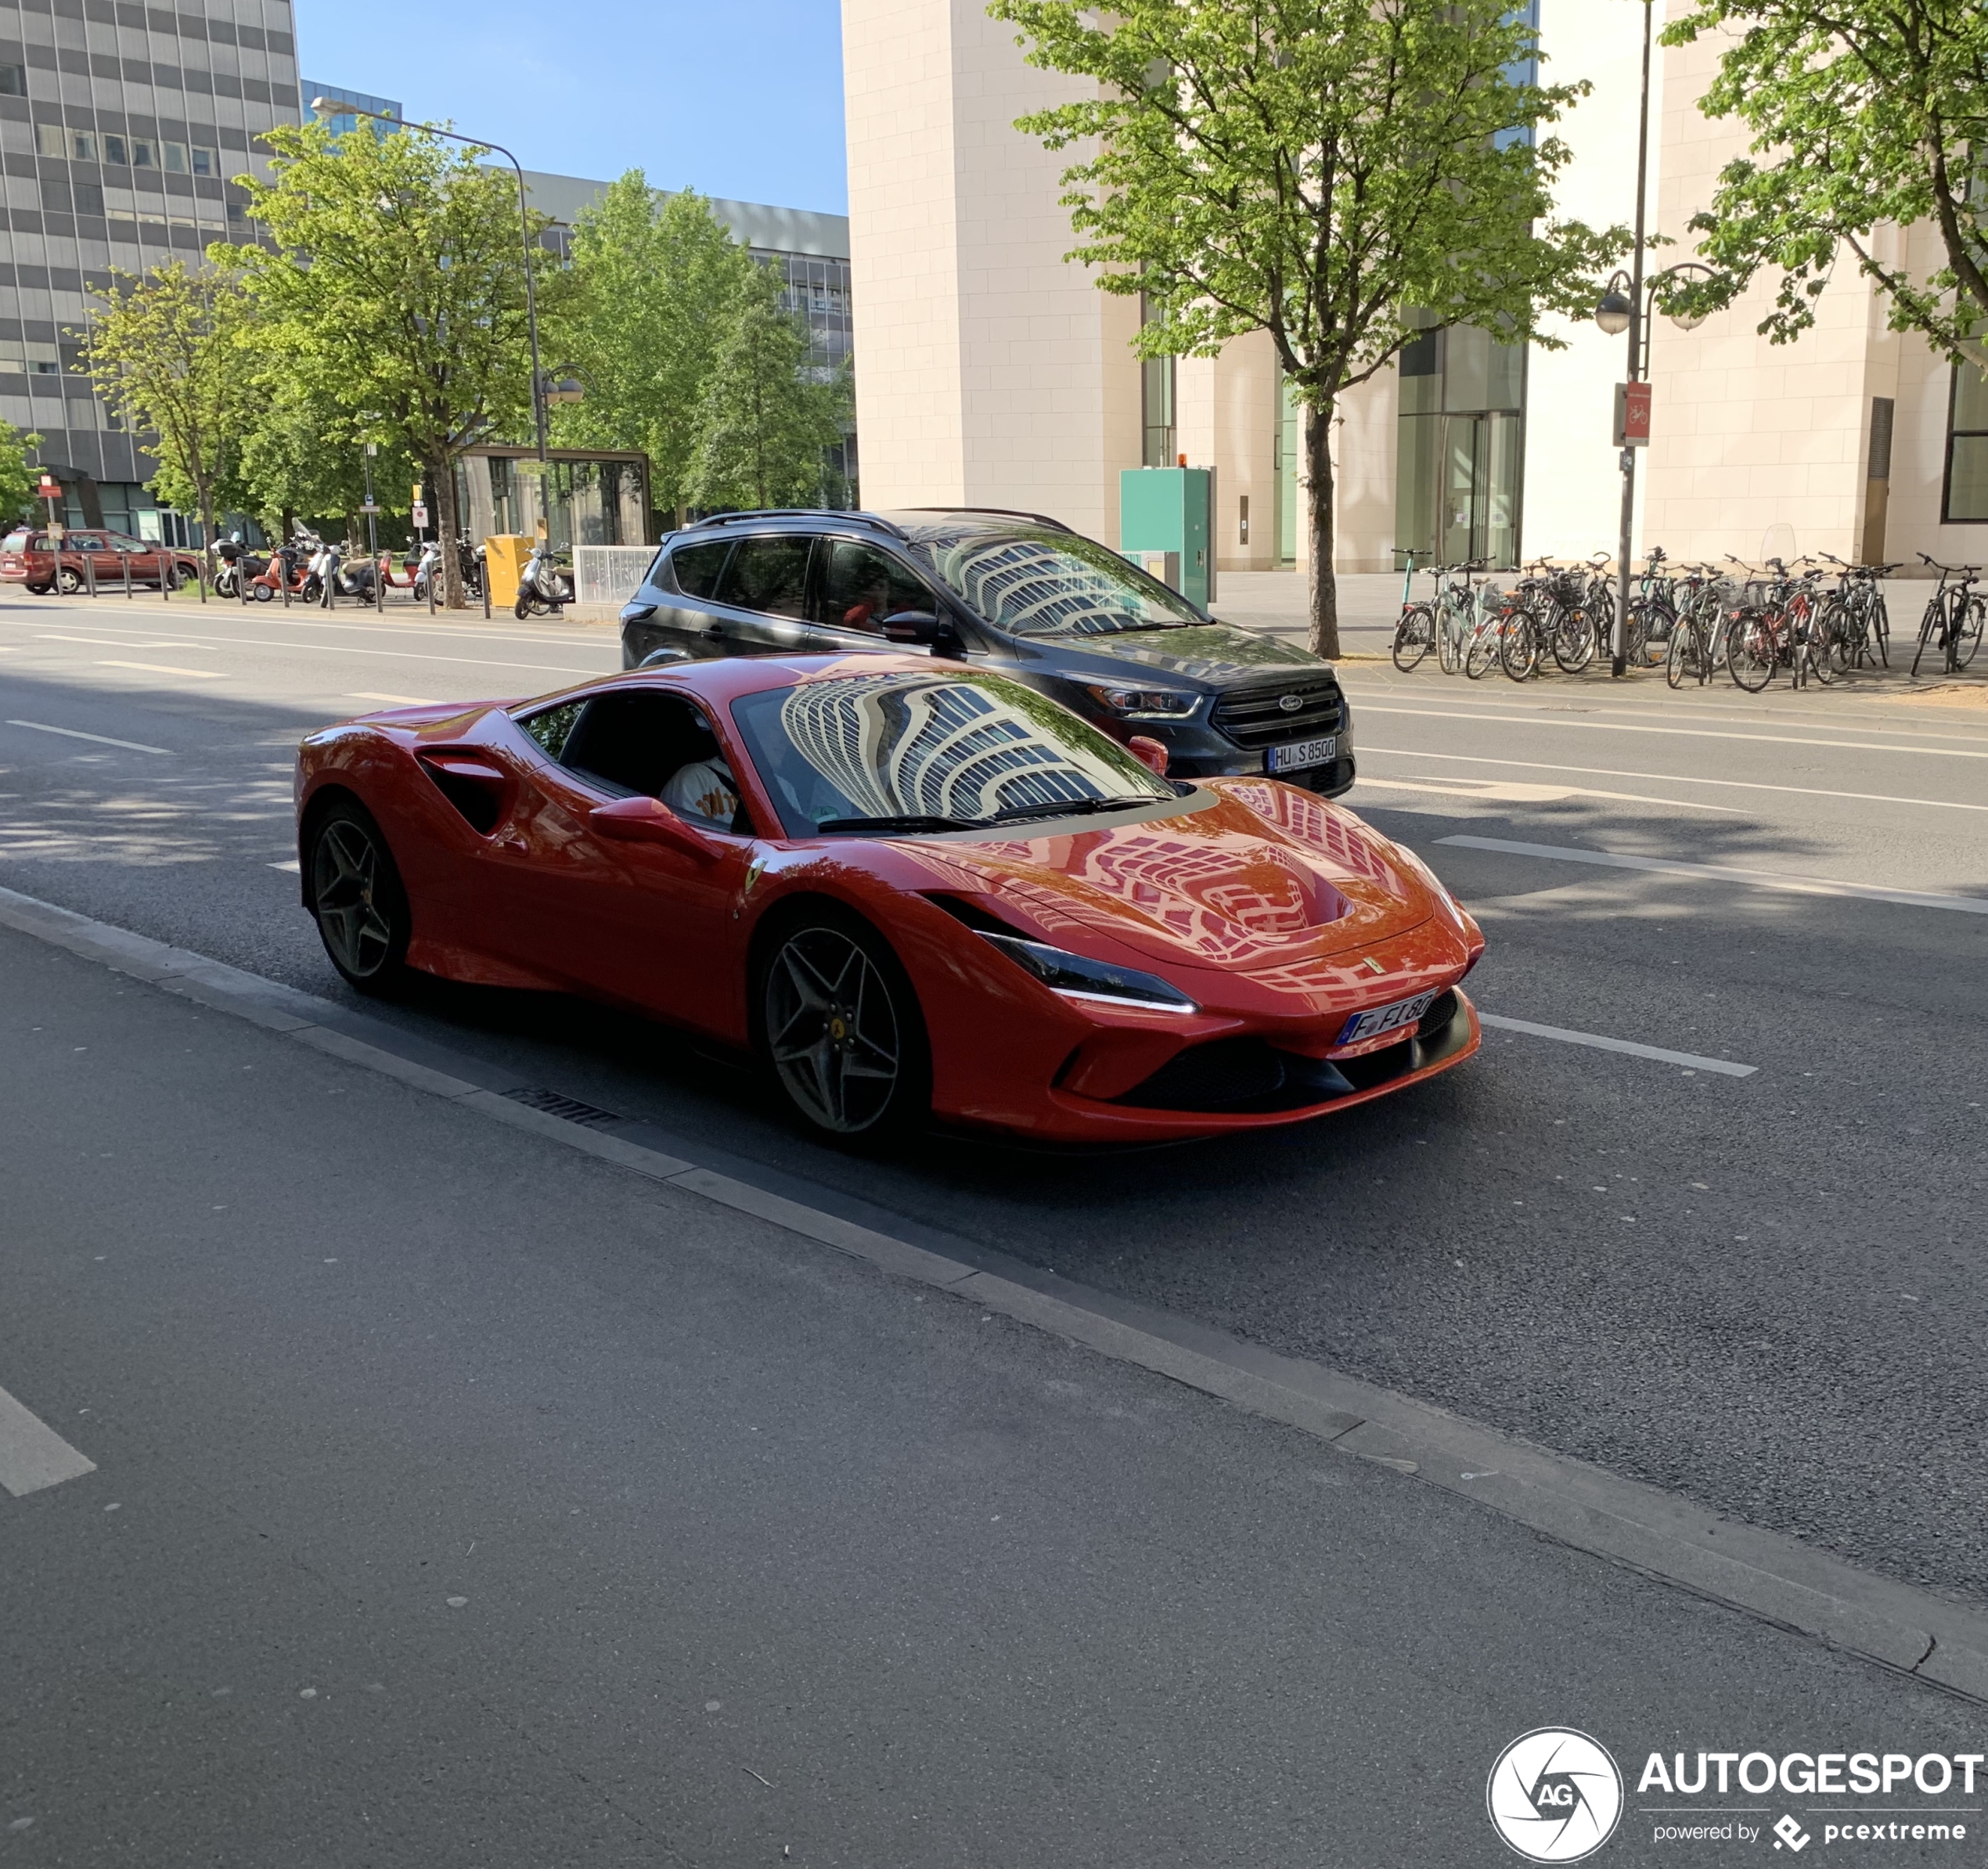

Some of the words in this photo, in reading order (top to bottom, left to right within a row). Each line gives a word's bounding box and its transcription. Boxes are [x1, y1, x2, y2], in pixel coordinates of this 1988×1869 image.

[1285, 697, 1299, 708] Ford
[1276, 748, 1291, 767] HU
[1298, 745, 1306, 762] S
[1308, 739, 1334, 760] 8500
[1352, 1014, 1374, 1038] F
